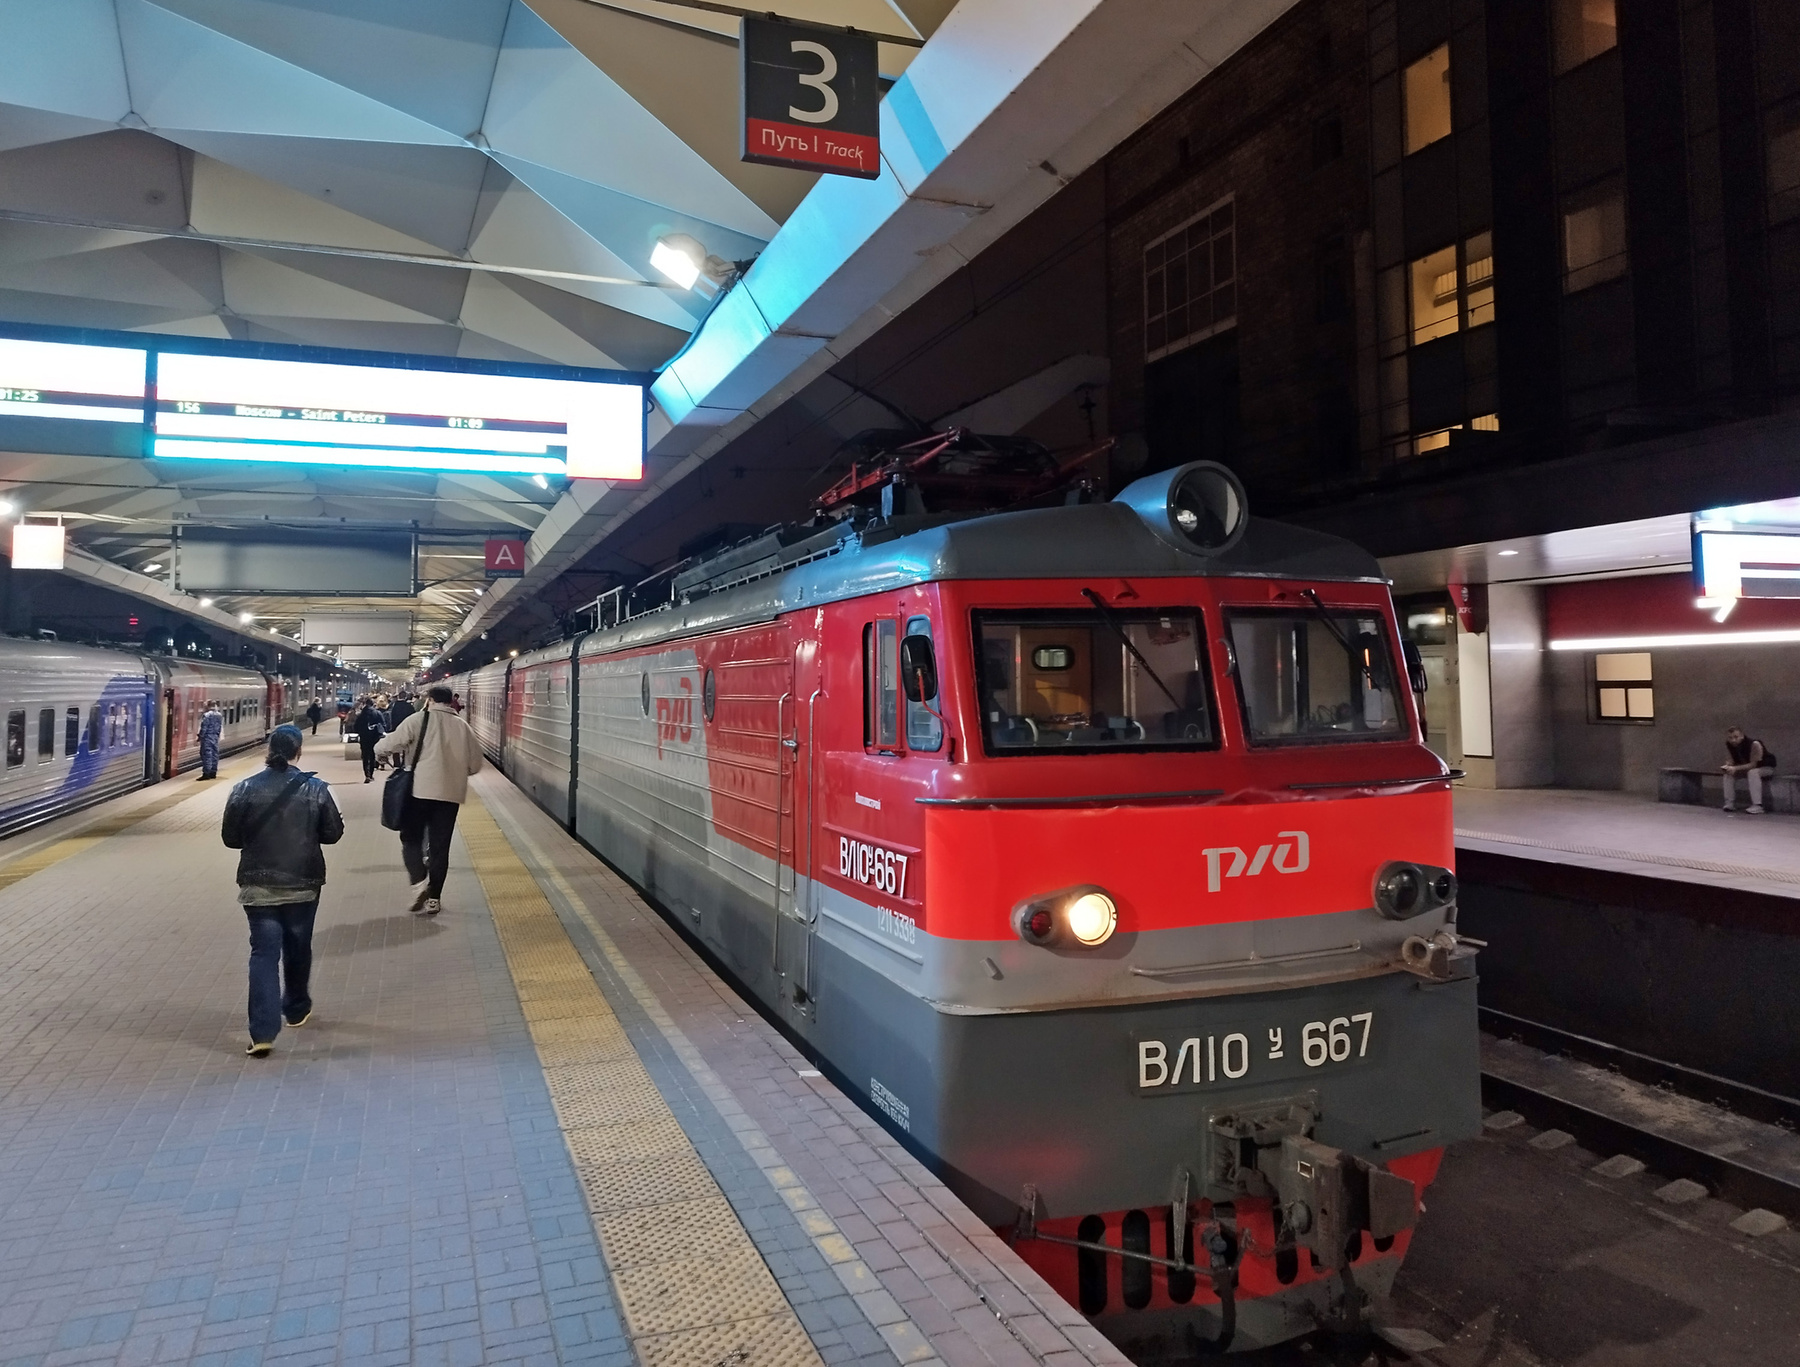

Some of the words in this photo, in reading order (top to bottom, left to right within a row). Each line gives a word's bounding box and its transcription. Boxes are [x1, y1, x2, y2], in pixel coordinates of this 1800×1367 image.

[789, 40, 839, 124] 3
[762, 128, 809, 152] Путь
[825, 141, 864, 160] Track
[176, 401, 201, 414] 156
[235, 405, 282, 418] Moscow
[301, 408, 339, 421] Saint
[343, 411, 386, 423] Peters
[1139, 1033, 1249, 1088] ВЛ10
[1302, 1012, 1373, 1067] 667
